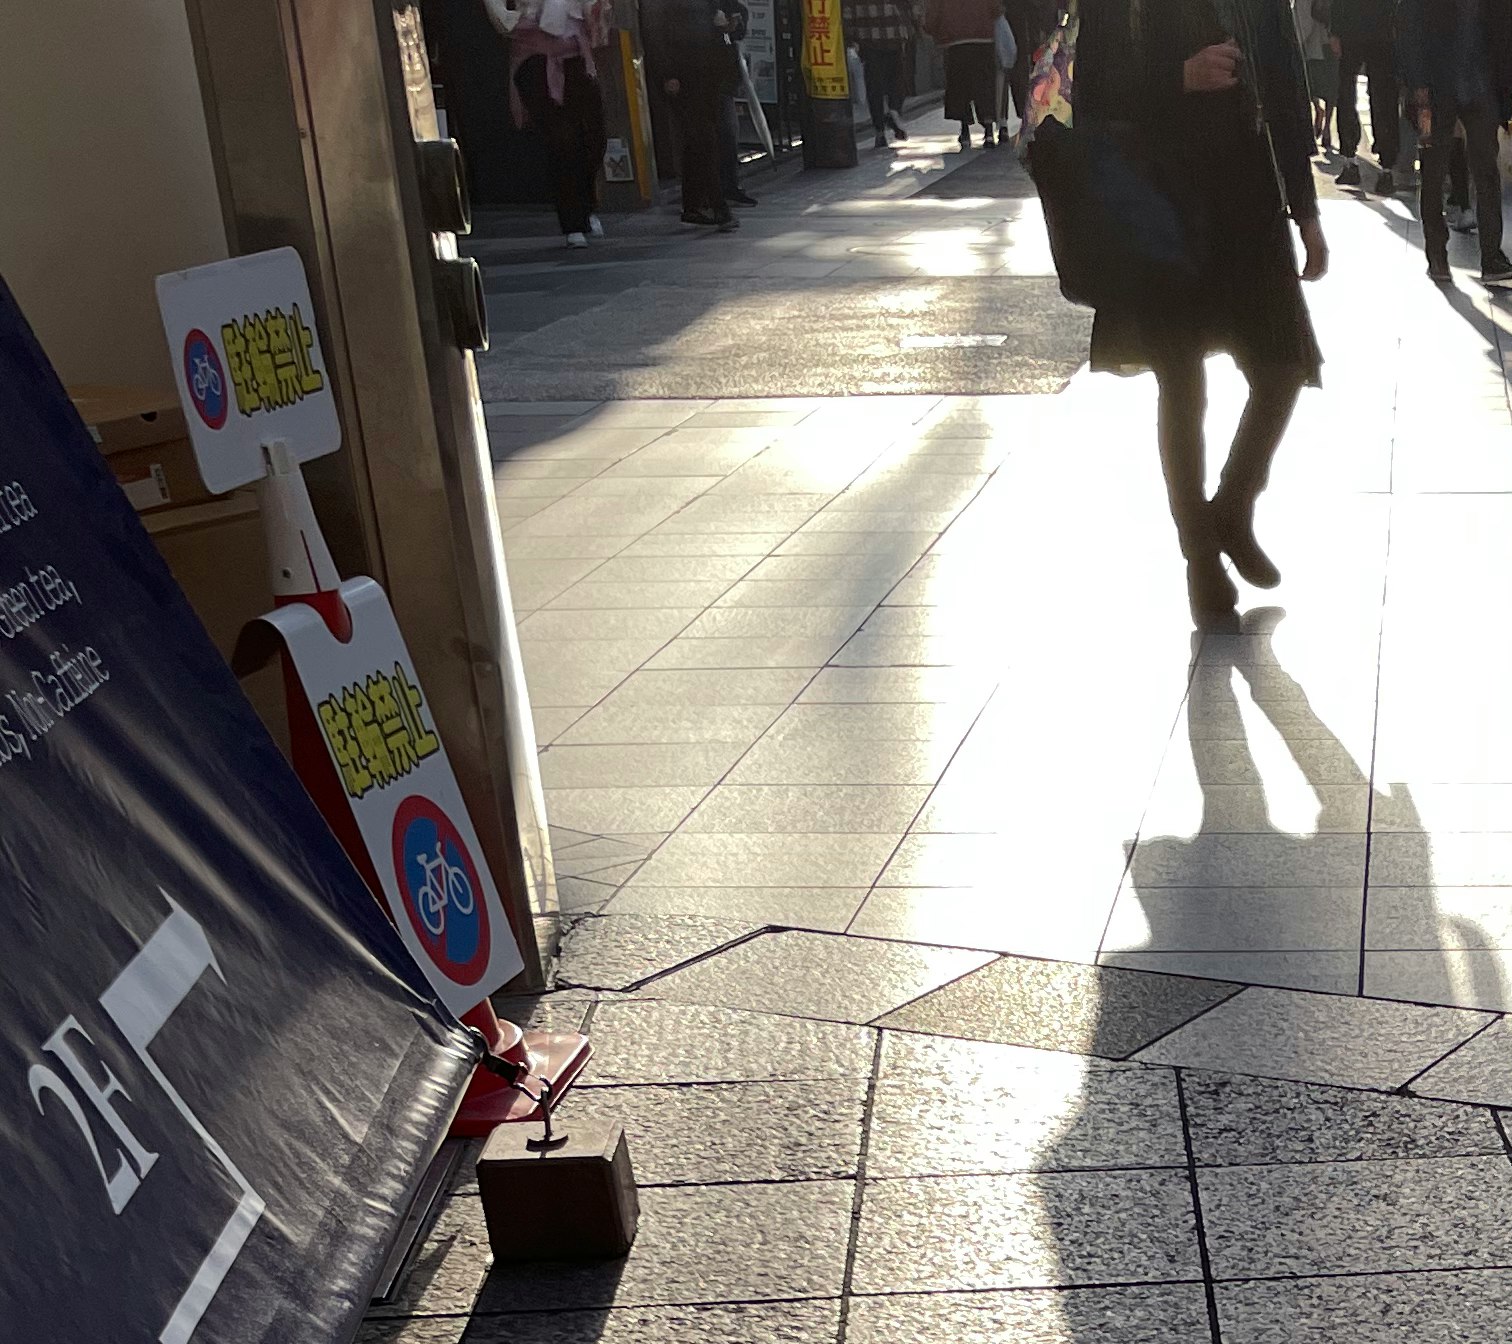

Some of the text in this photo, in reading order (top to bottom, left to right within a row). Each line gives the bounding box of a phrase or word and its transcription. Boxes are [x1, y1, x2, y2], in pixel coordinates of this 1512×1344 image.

[221, 302, 324, 417] 駐輪禁止
[24, 565, 82, 611] tea,
[5, 643, 110, 741] Non-Caffeine
[317, 660, 440, 800] 駐輪禁止
[28, 1013, 160, 1216] 2F
